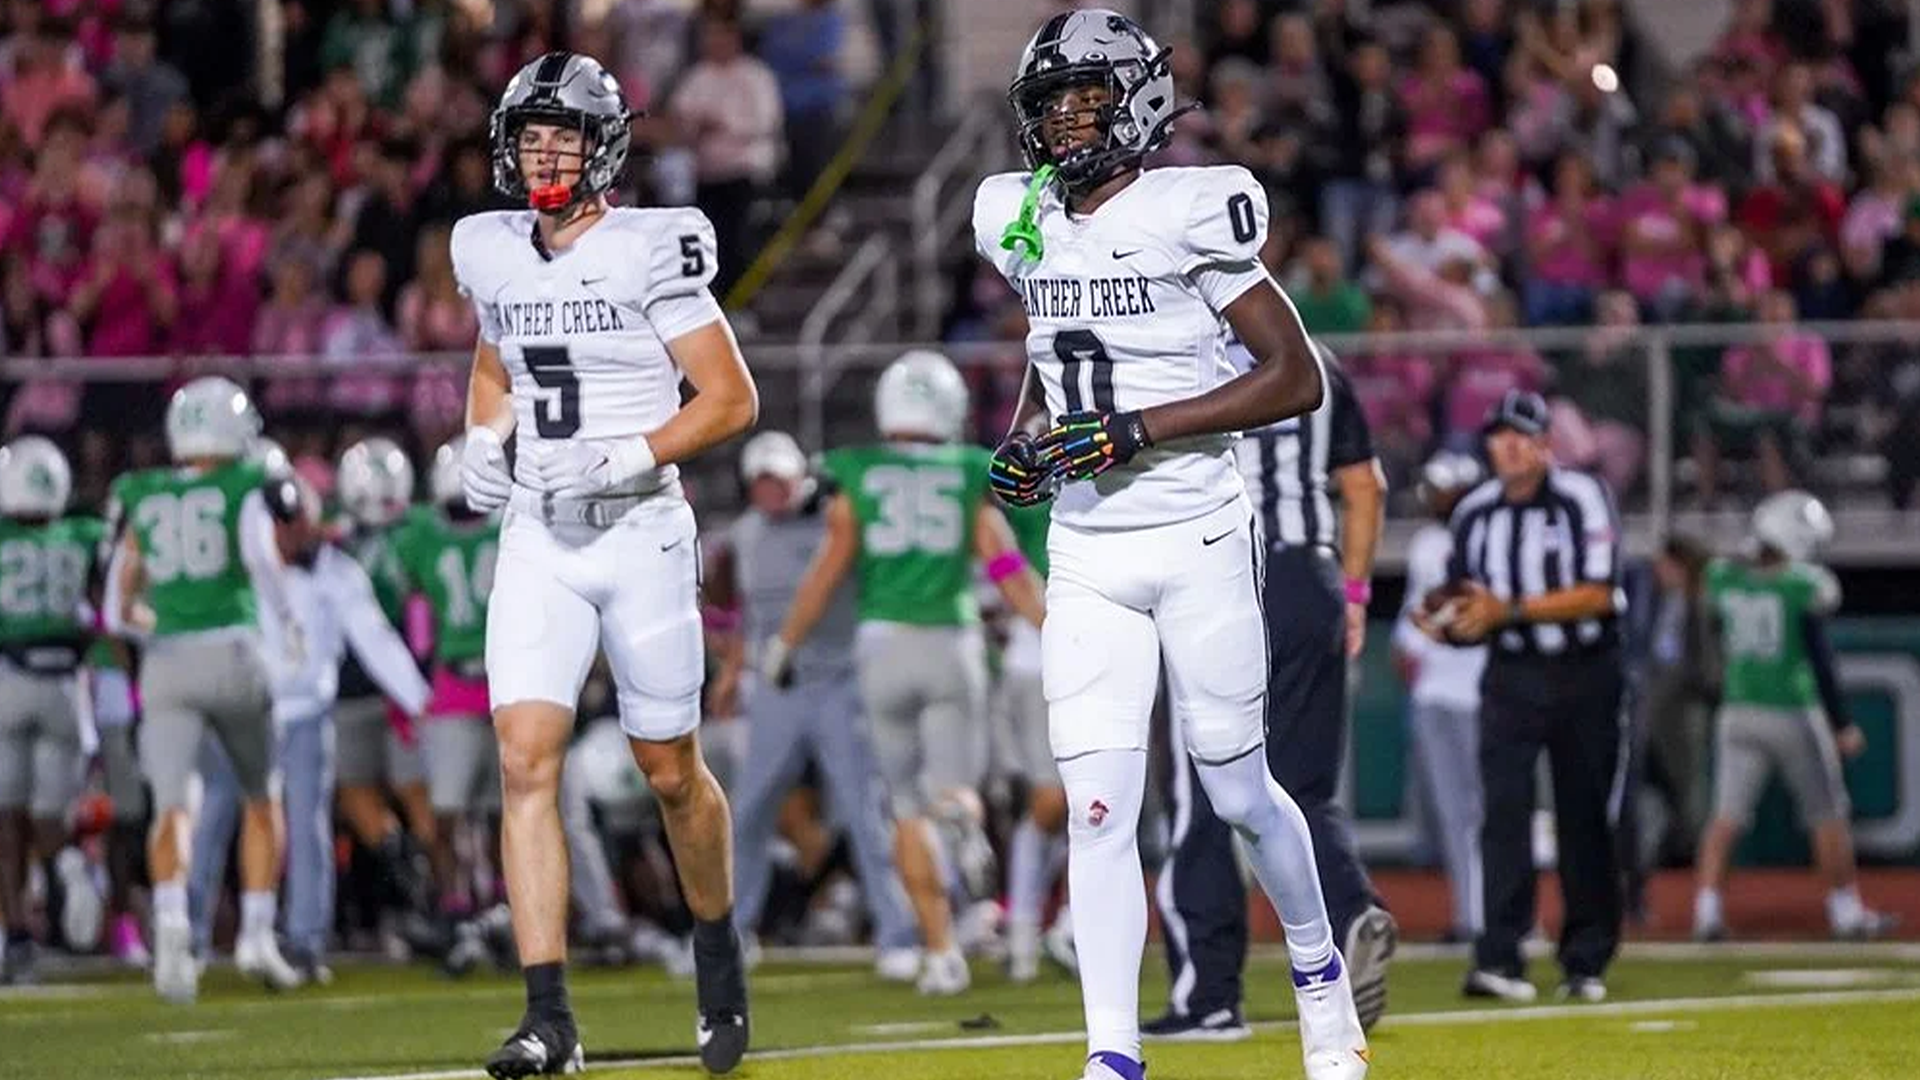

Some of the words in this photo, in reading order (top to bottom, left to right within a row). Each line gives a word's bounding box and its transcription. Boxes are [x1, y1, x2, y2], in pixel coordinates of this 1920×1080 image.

[1228, 192, 1257, 244] 0
[679, 235, 704, 276] 5
[562, 299, 623, 334] CREEK
[1089, 276, 1155, 317] CREEK
[522, 346, 580, 439] 5
[137, 487, 228, 581] 36
[861, 465, 965, 556] 35
